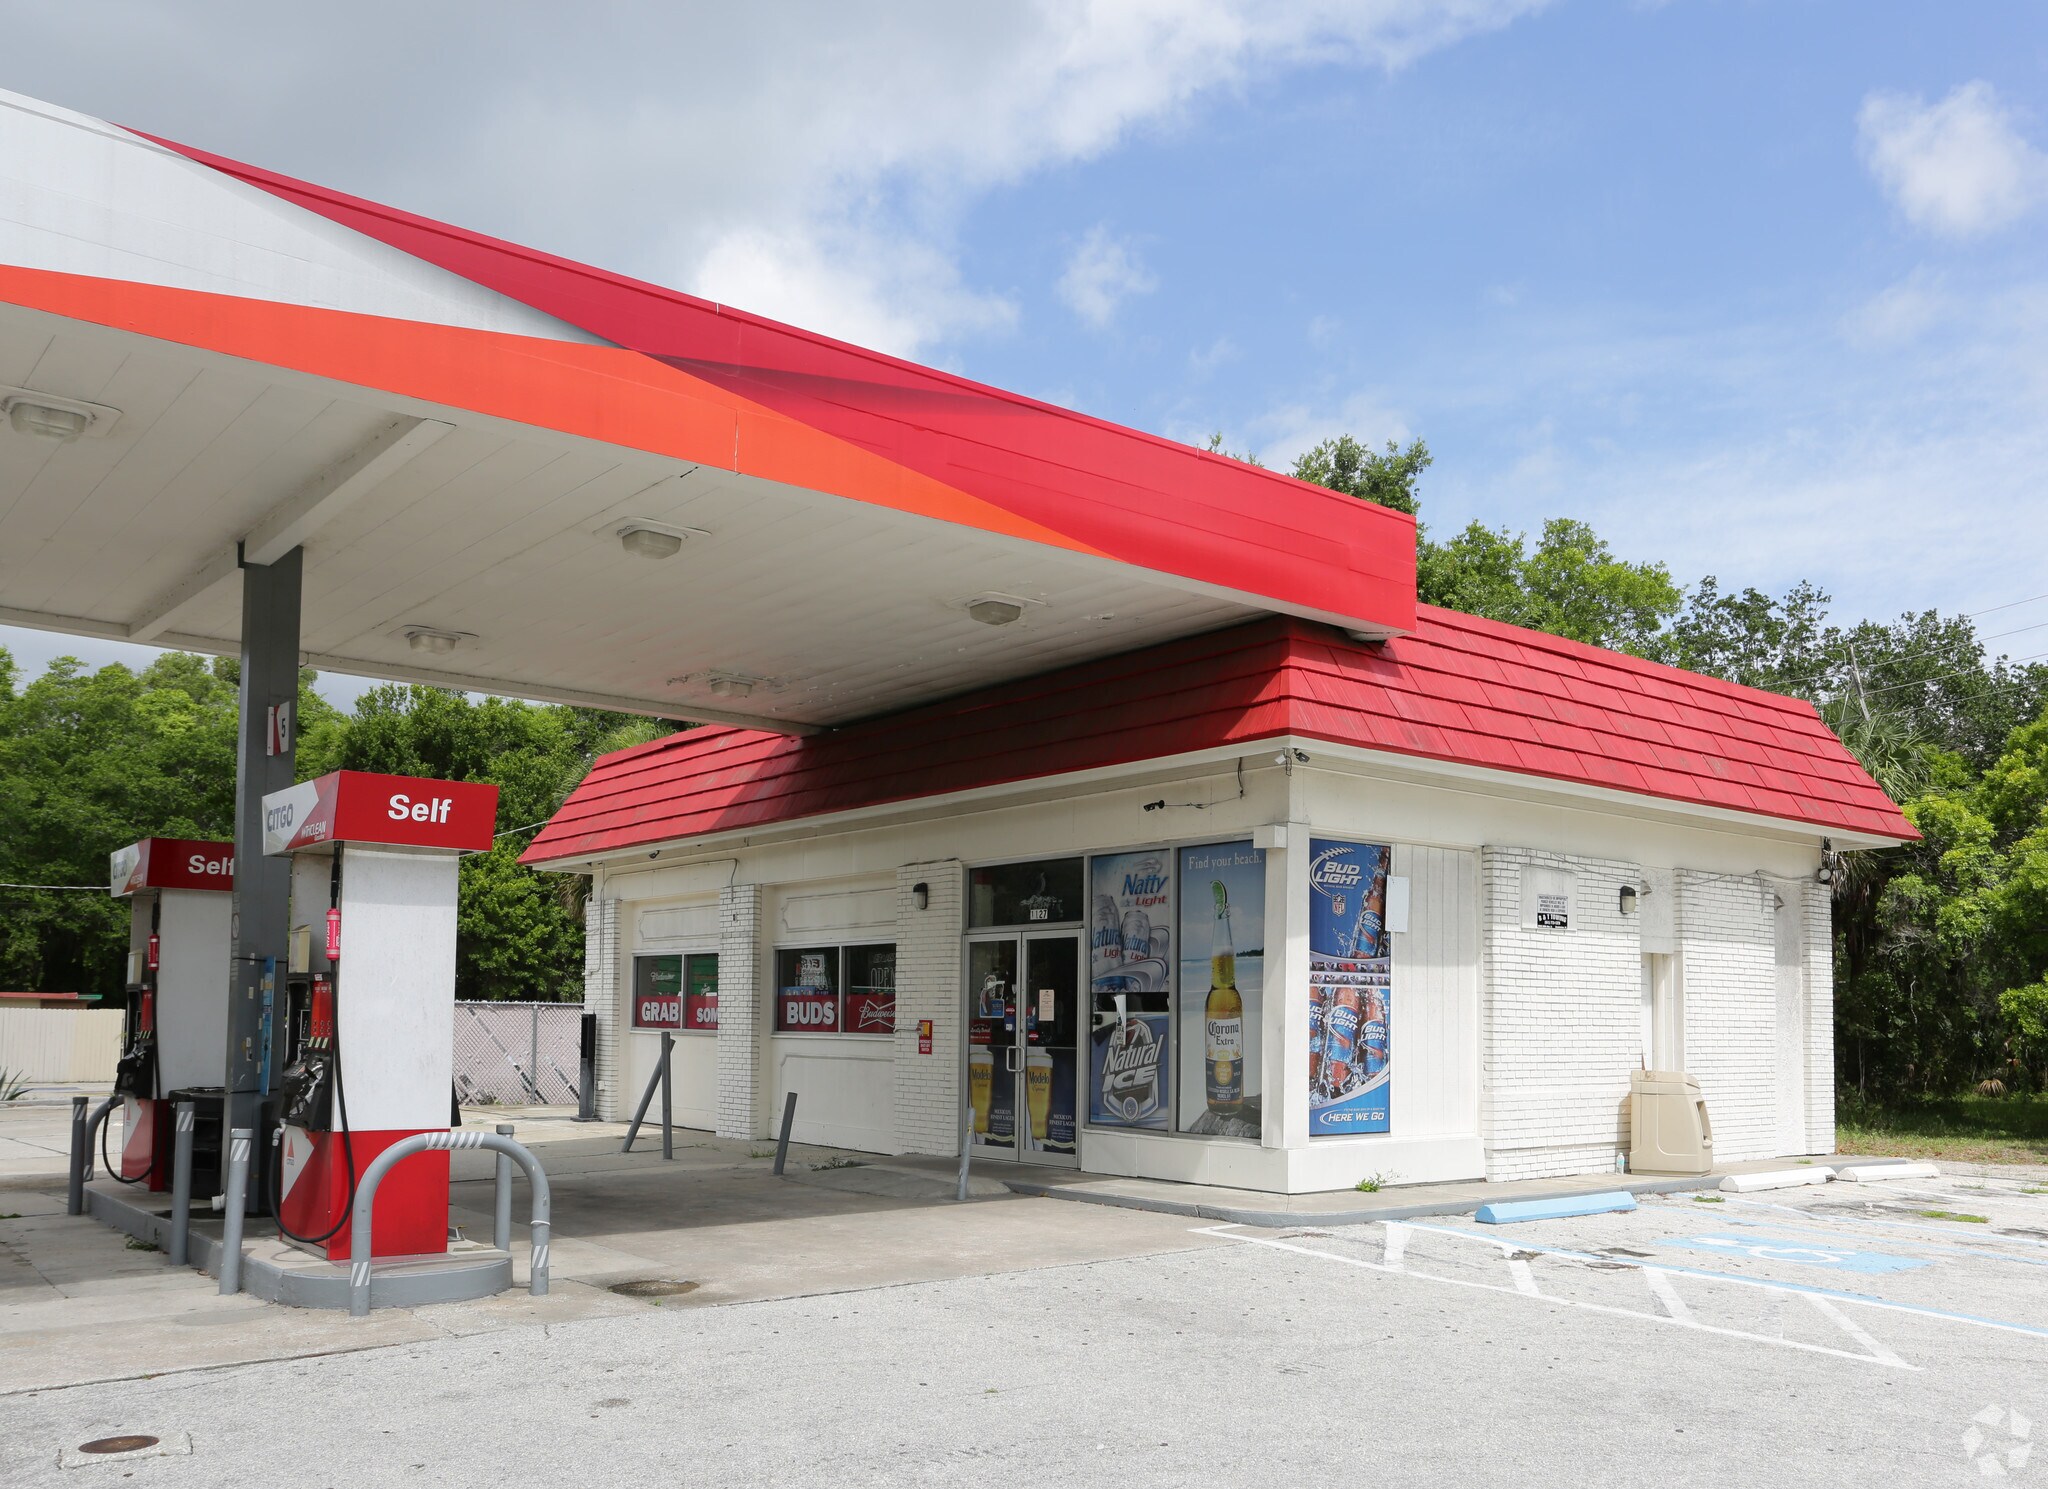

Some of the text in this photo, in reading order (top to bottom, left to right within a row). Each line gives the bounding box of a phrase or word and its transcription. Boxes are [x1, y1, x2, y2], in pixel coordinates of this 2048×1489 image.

[281, 717, 286, 738] 5
[387, 793, 453, 824] Self
[266, 803, 294, 833] CITGO
[187, 854, 235, 877] Self
[1188, 852, 1262, 871] Find your beach.
[1323, 861, 1361, 875] BUD
[1121, 873, 1169, 897] Natty
[1314, 871, 1363, 886] LIGHT
[1135, 895, 1167, 907] Light
[1031, 909, 1048, 920] 1127
[1363, 913, 1383, 927] BUD
[641, 1001, 679, 1022] GRAB
[786, 1001, 835, 1025] BUDS
[1334, 1009, 1358, 1023] BUD
[1208, 1020, 1240, 1037] Corona
[1364, 1025, 1386, 1033] BUD
[1215, 1035, 1235, 1046] Extra
[1361, 1033, 1386, 1041] LIGHT
[1102, 1034, 1164, 1075] Natural
[971, 1068, 993, 1080] Modelo
[1029, 1071, 1050, 1085] Modelo
[1102, 1064, 1157, 1093] ICE
[1328, 1111, 1385, 1122] HERE WE GO
